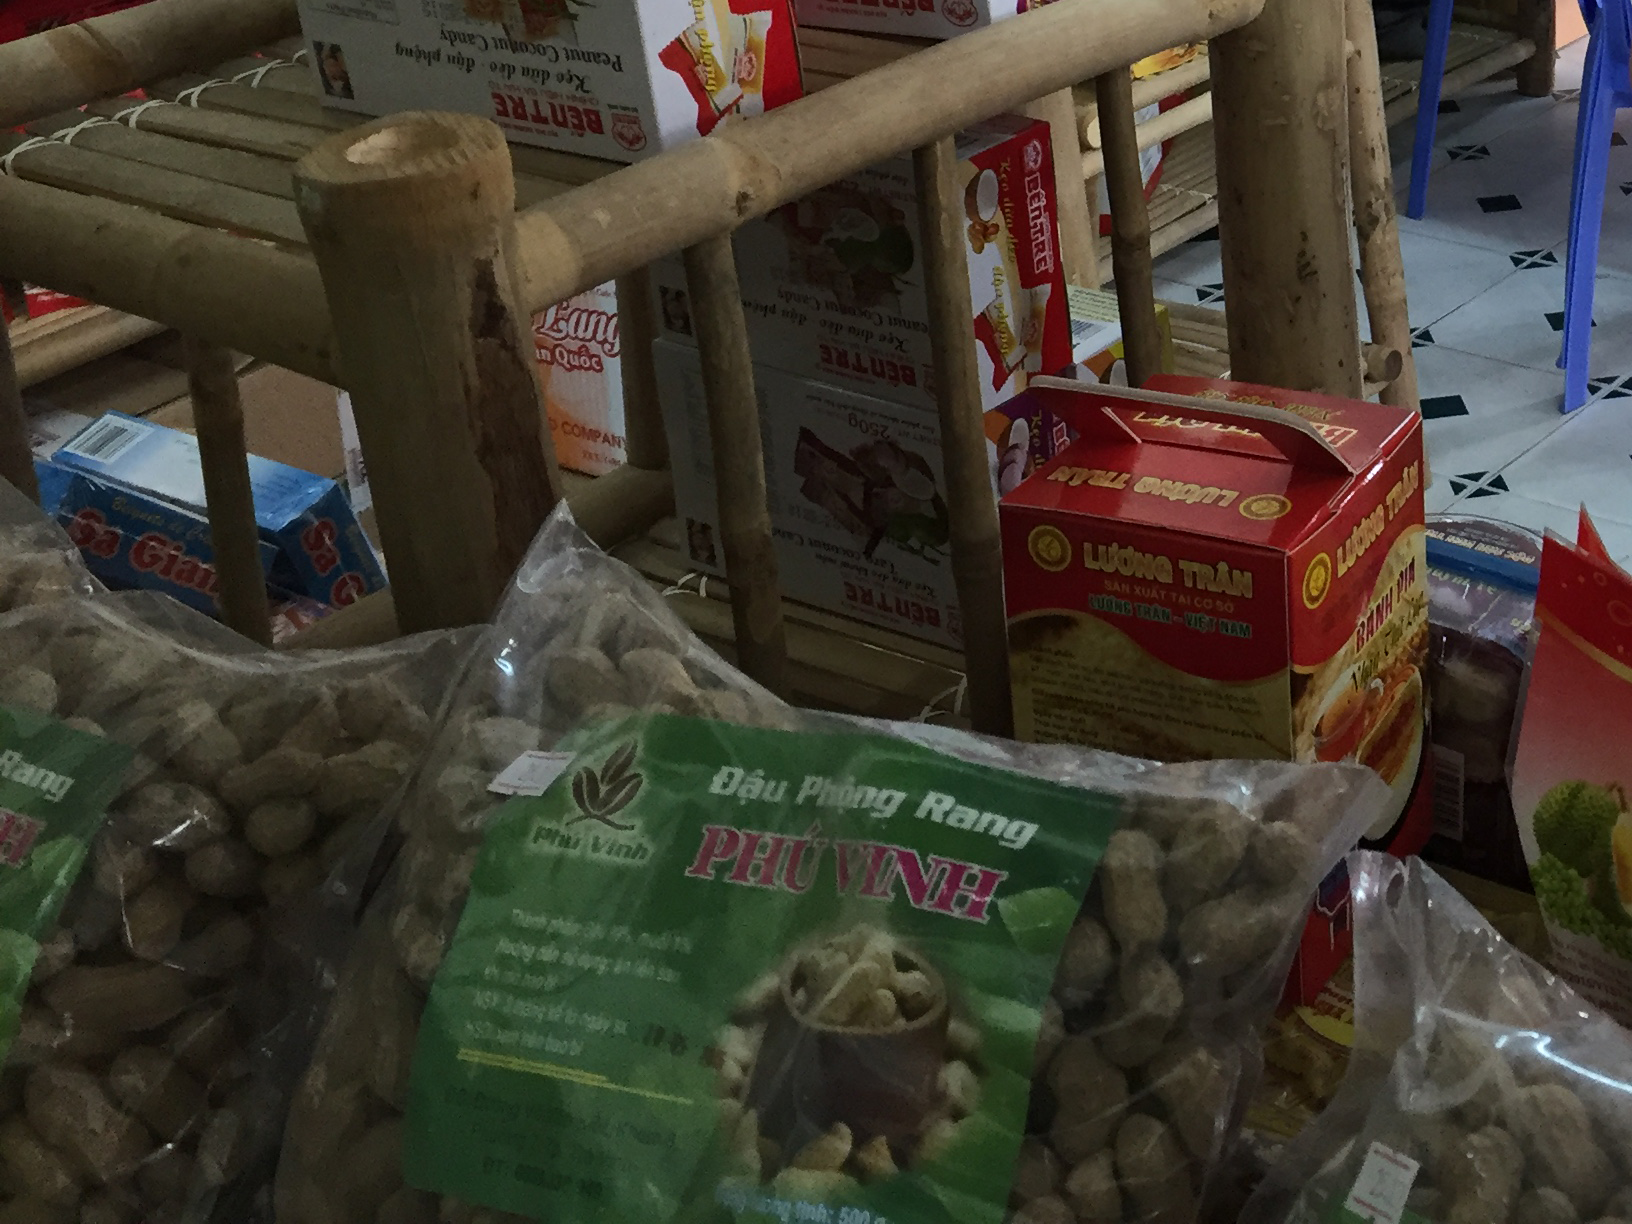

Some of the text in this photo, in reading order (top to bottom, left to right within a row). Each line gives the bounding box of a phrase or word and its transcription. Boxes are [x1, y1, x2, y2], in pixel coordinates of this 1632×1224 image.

[439, 24, 489, 53] Candy
[564, 46, 623, 73] Peanut
[887, 315, 929, 333] eanut
[129, 531, 219, 597] Gian
[1083, 541, 1253, 599] LƯƠNG TRÂN
[1219, 620, 1252, 638] NAM
[709, 765, 788, 805] Đậu
[914, 790, 1039, 850] Rang
[685, 818, 1009, 925] PHÚ VINH
